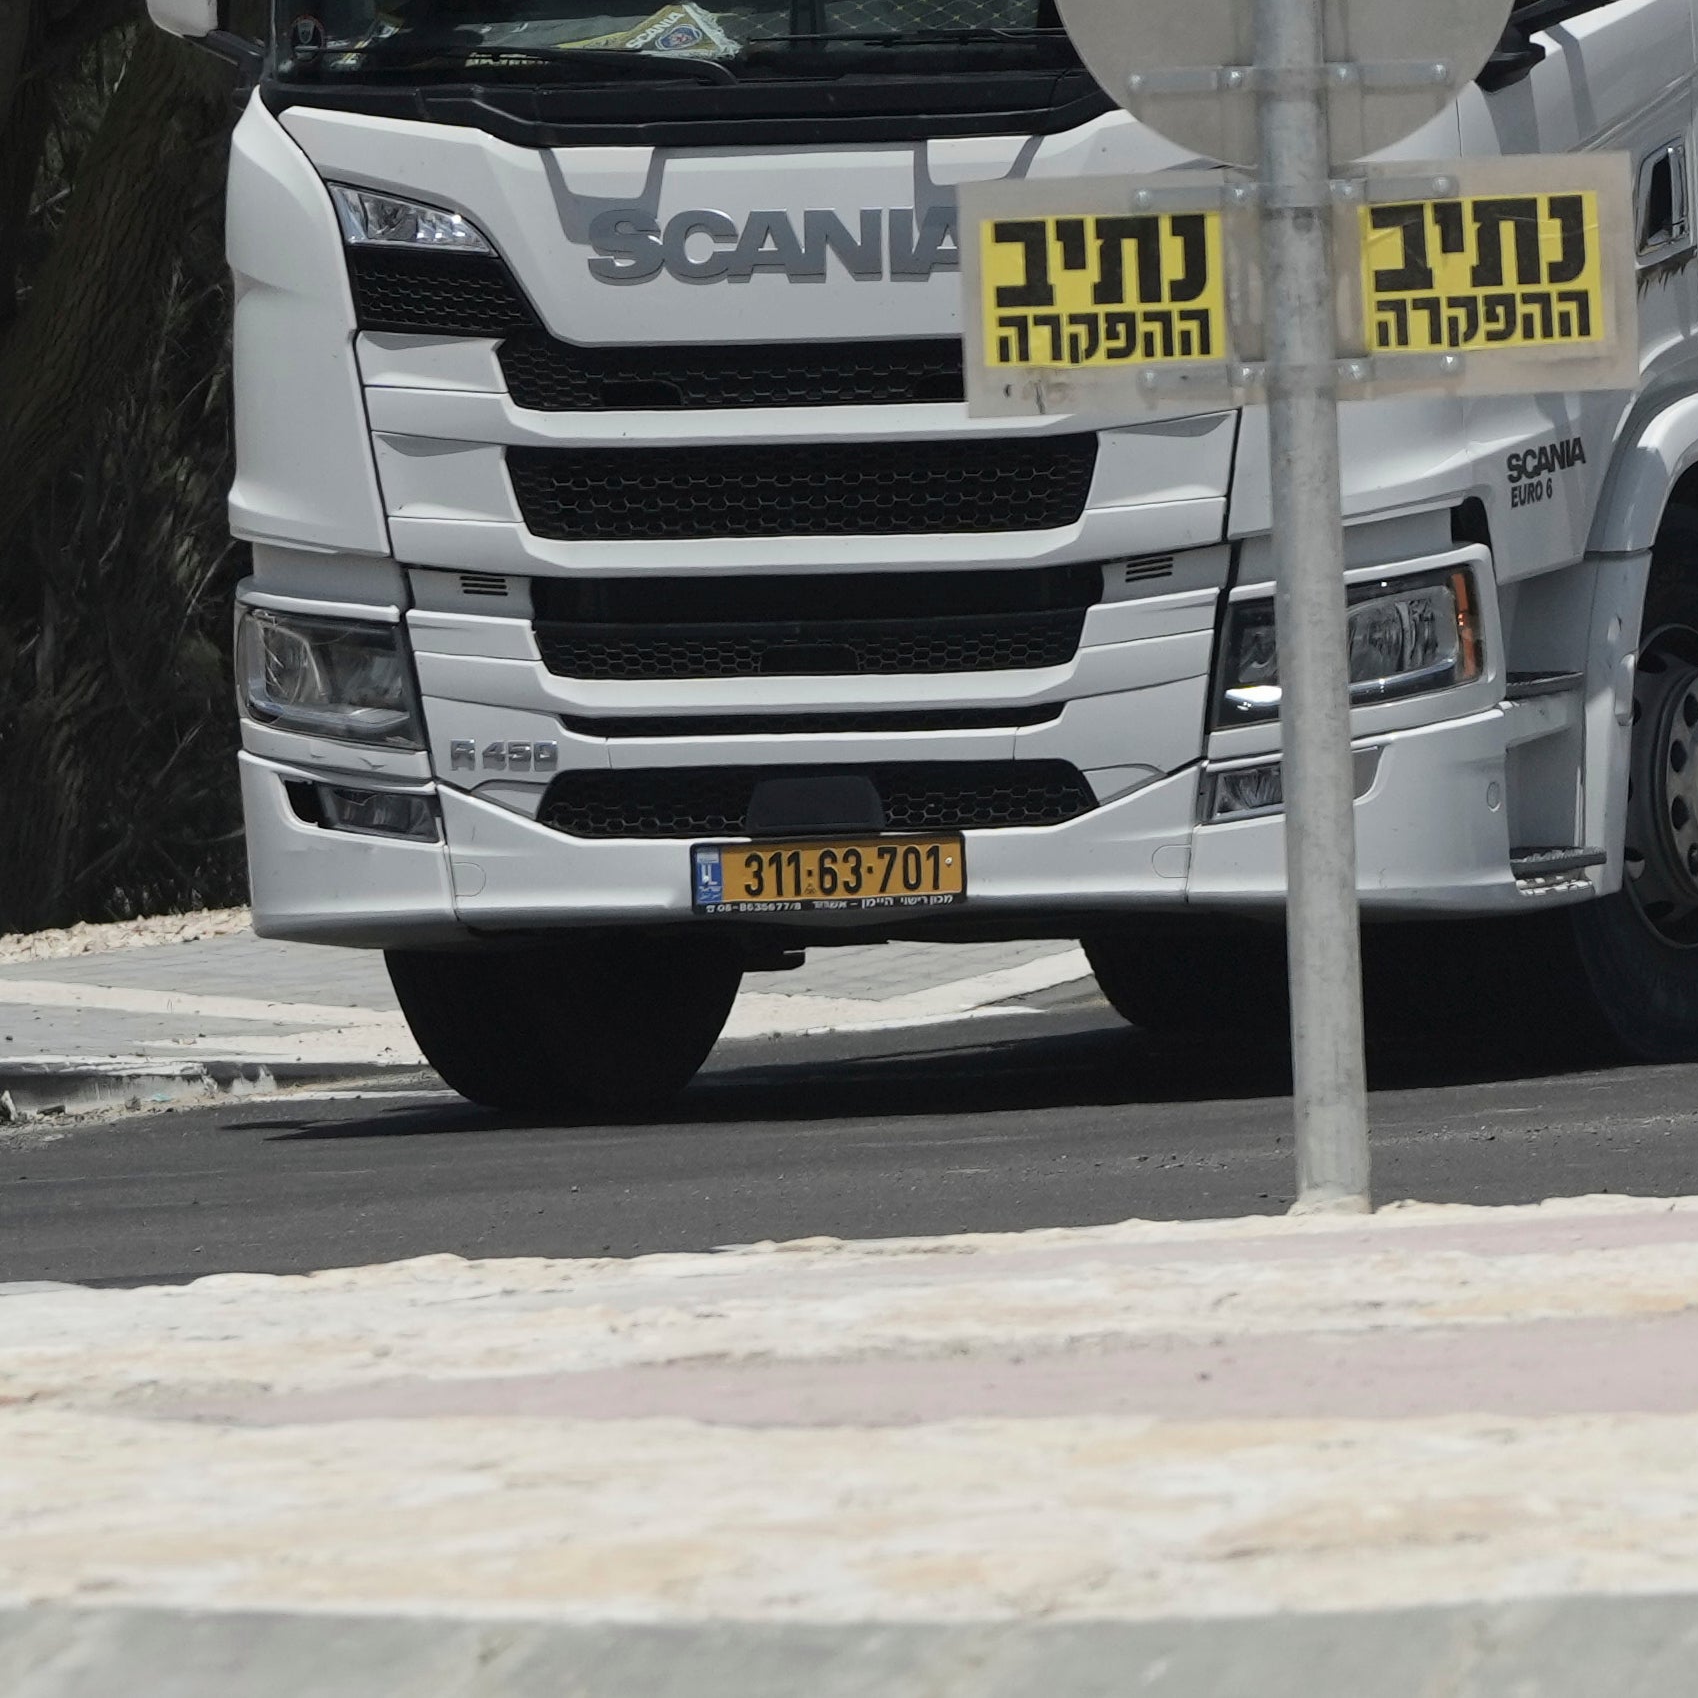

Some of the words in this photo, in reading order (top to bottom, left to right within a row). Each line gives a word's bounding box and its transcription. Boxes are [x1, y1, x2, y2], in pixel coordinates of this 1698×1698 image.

[626, 11, 686, 49] SCANIA
[993, 214, 1207, 308] נתיב
[1369, 195, 1586, 292] נתיב
[999, 309, 1211, 364] ההפקרה
[1374, 290, 1590, 348] ההפקרה
[1507, 437, 1586, 483] SCANIA
[1511, 480, 1543, 508] EURO
[1546, 477, 1553, 499] 6
[450, 739, 475, 771] R
[481, 740, 558, 772] 450
